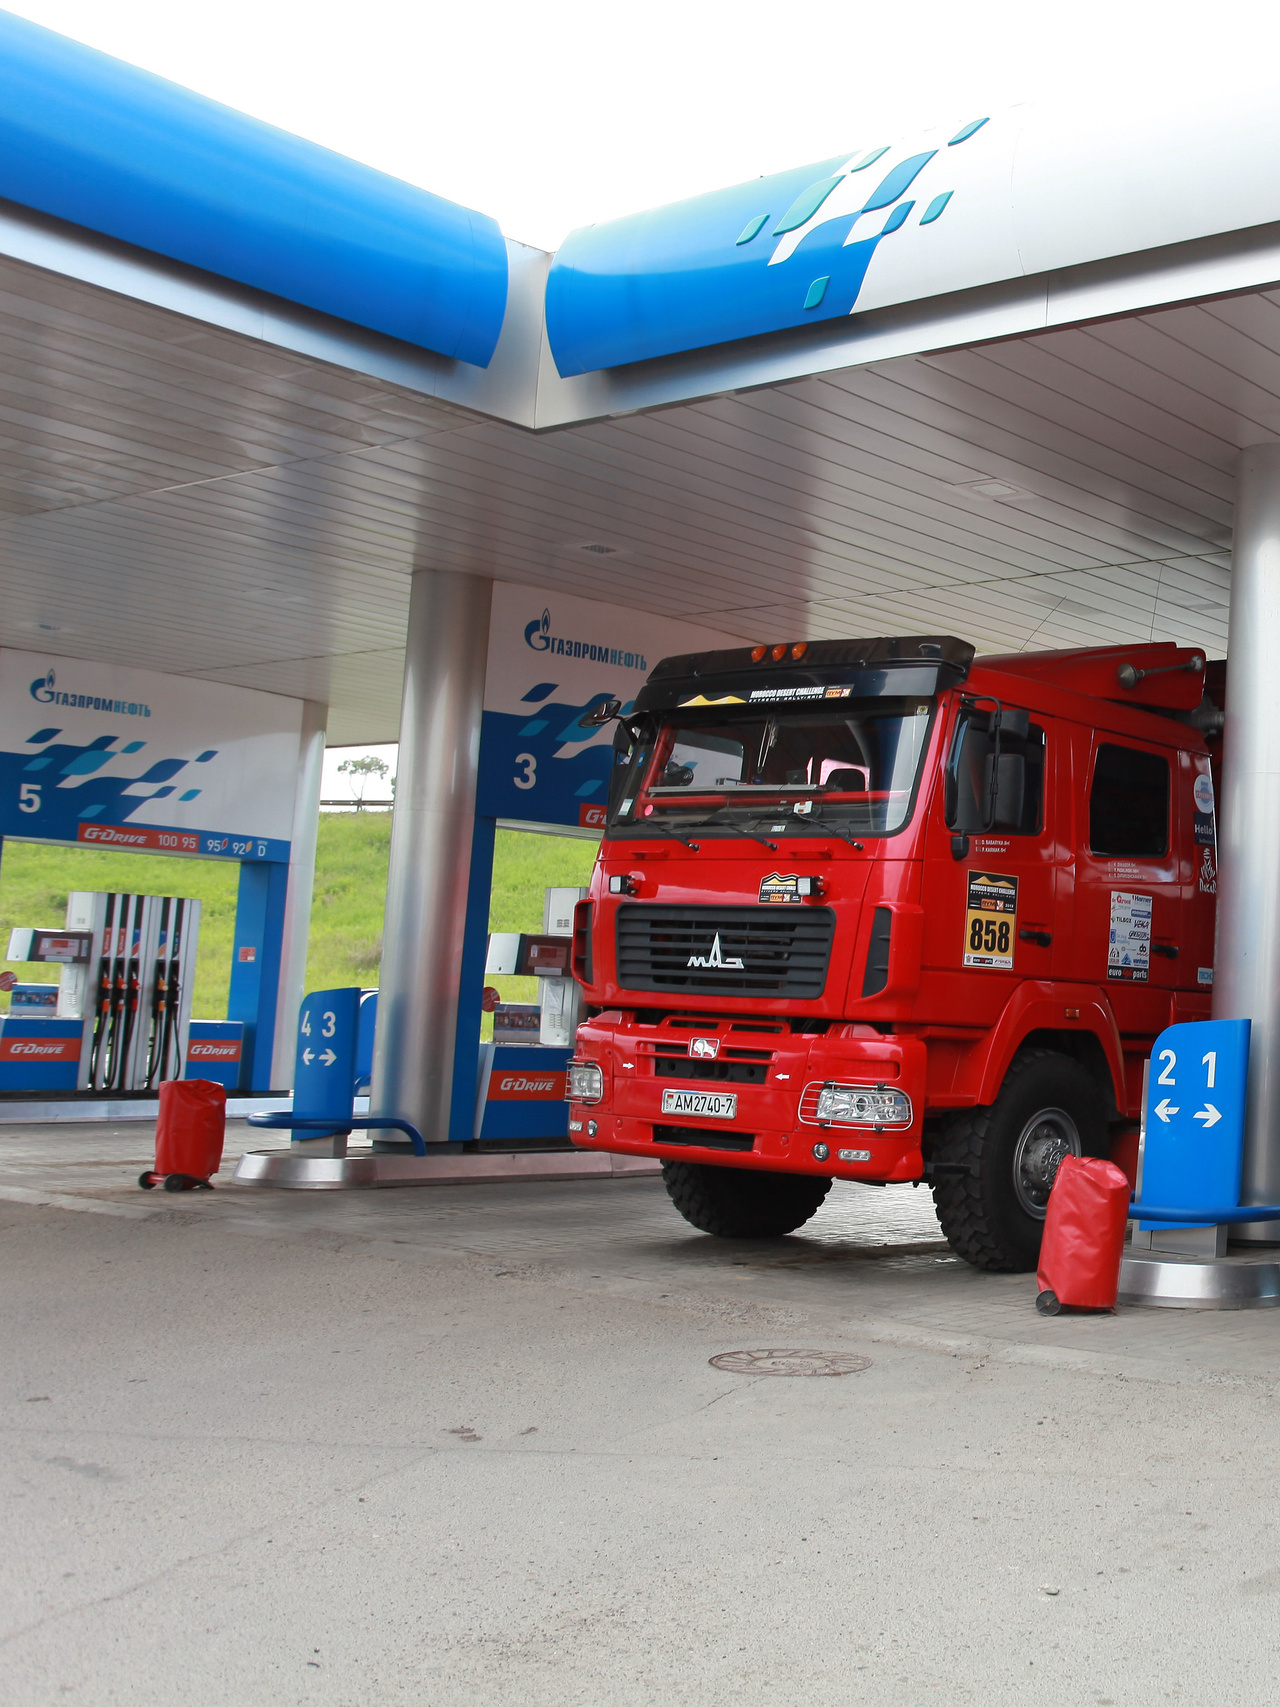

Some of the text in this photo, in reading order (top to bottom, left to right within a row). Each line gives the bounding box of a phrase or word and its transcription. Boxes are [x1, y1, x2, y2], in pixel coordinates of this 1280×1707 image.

[550, 637, 647, 671] ГАЗПРОМНЕФТЬ
[54, 690, 151, 718] ГАЗПРОМНЕФТЬ
[750, 686, 826, 699] MOROCCO DESERT CHALLENGE
[513, 752, 537, 790] 3
[18, 783, 42, 814] 5
[158, 834, 178, 848] 100
[182, 836, 196, 849] 95
[207, 839, 266, 857] 95 92 D
[970, 918, 1010, 954] 858
[301, 1010, 336, 1038] 4 3
[1158, 1049, 1217, 1088] 2 1
[674, 1094, 733, 1114] AM2740-7
